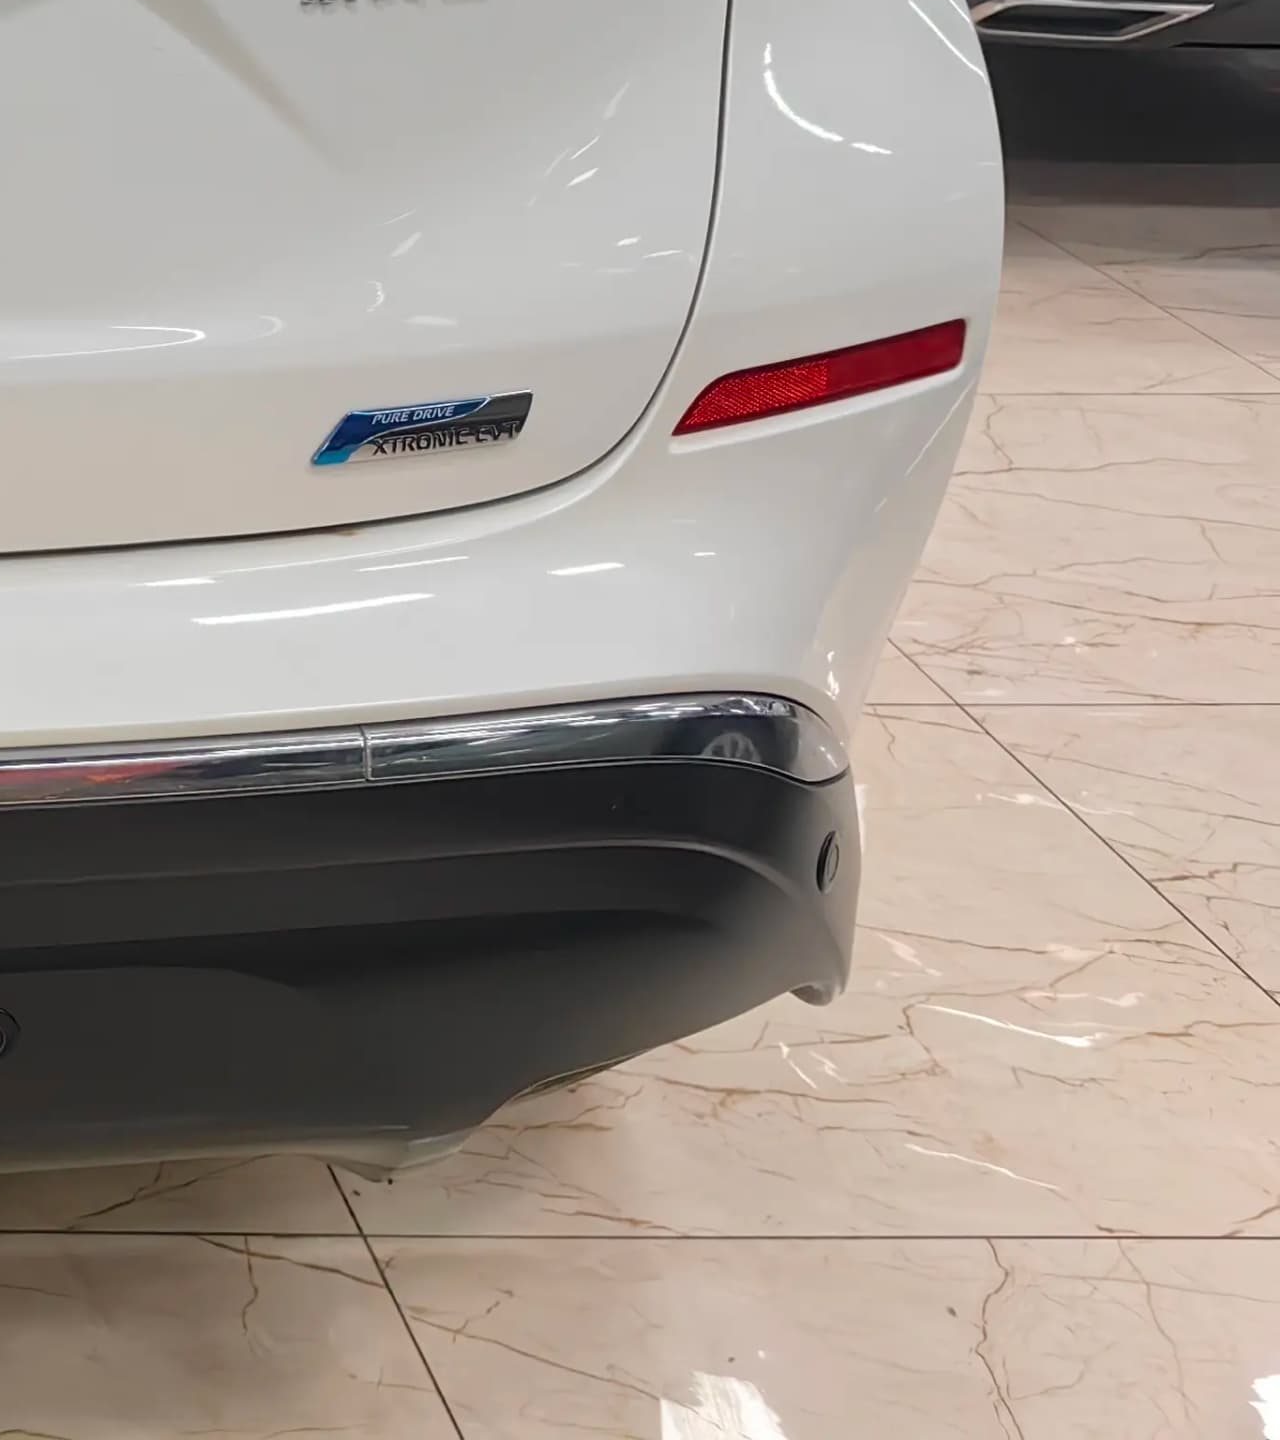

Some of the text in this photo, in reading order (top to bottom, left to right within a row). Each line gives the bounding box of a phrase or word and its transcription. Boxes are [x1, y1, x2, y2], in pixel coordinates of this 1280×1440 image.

[371, 405, 455, 426] PURE DRIVE
[372, 427, 470, 457] XTRONIC
